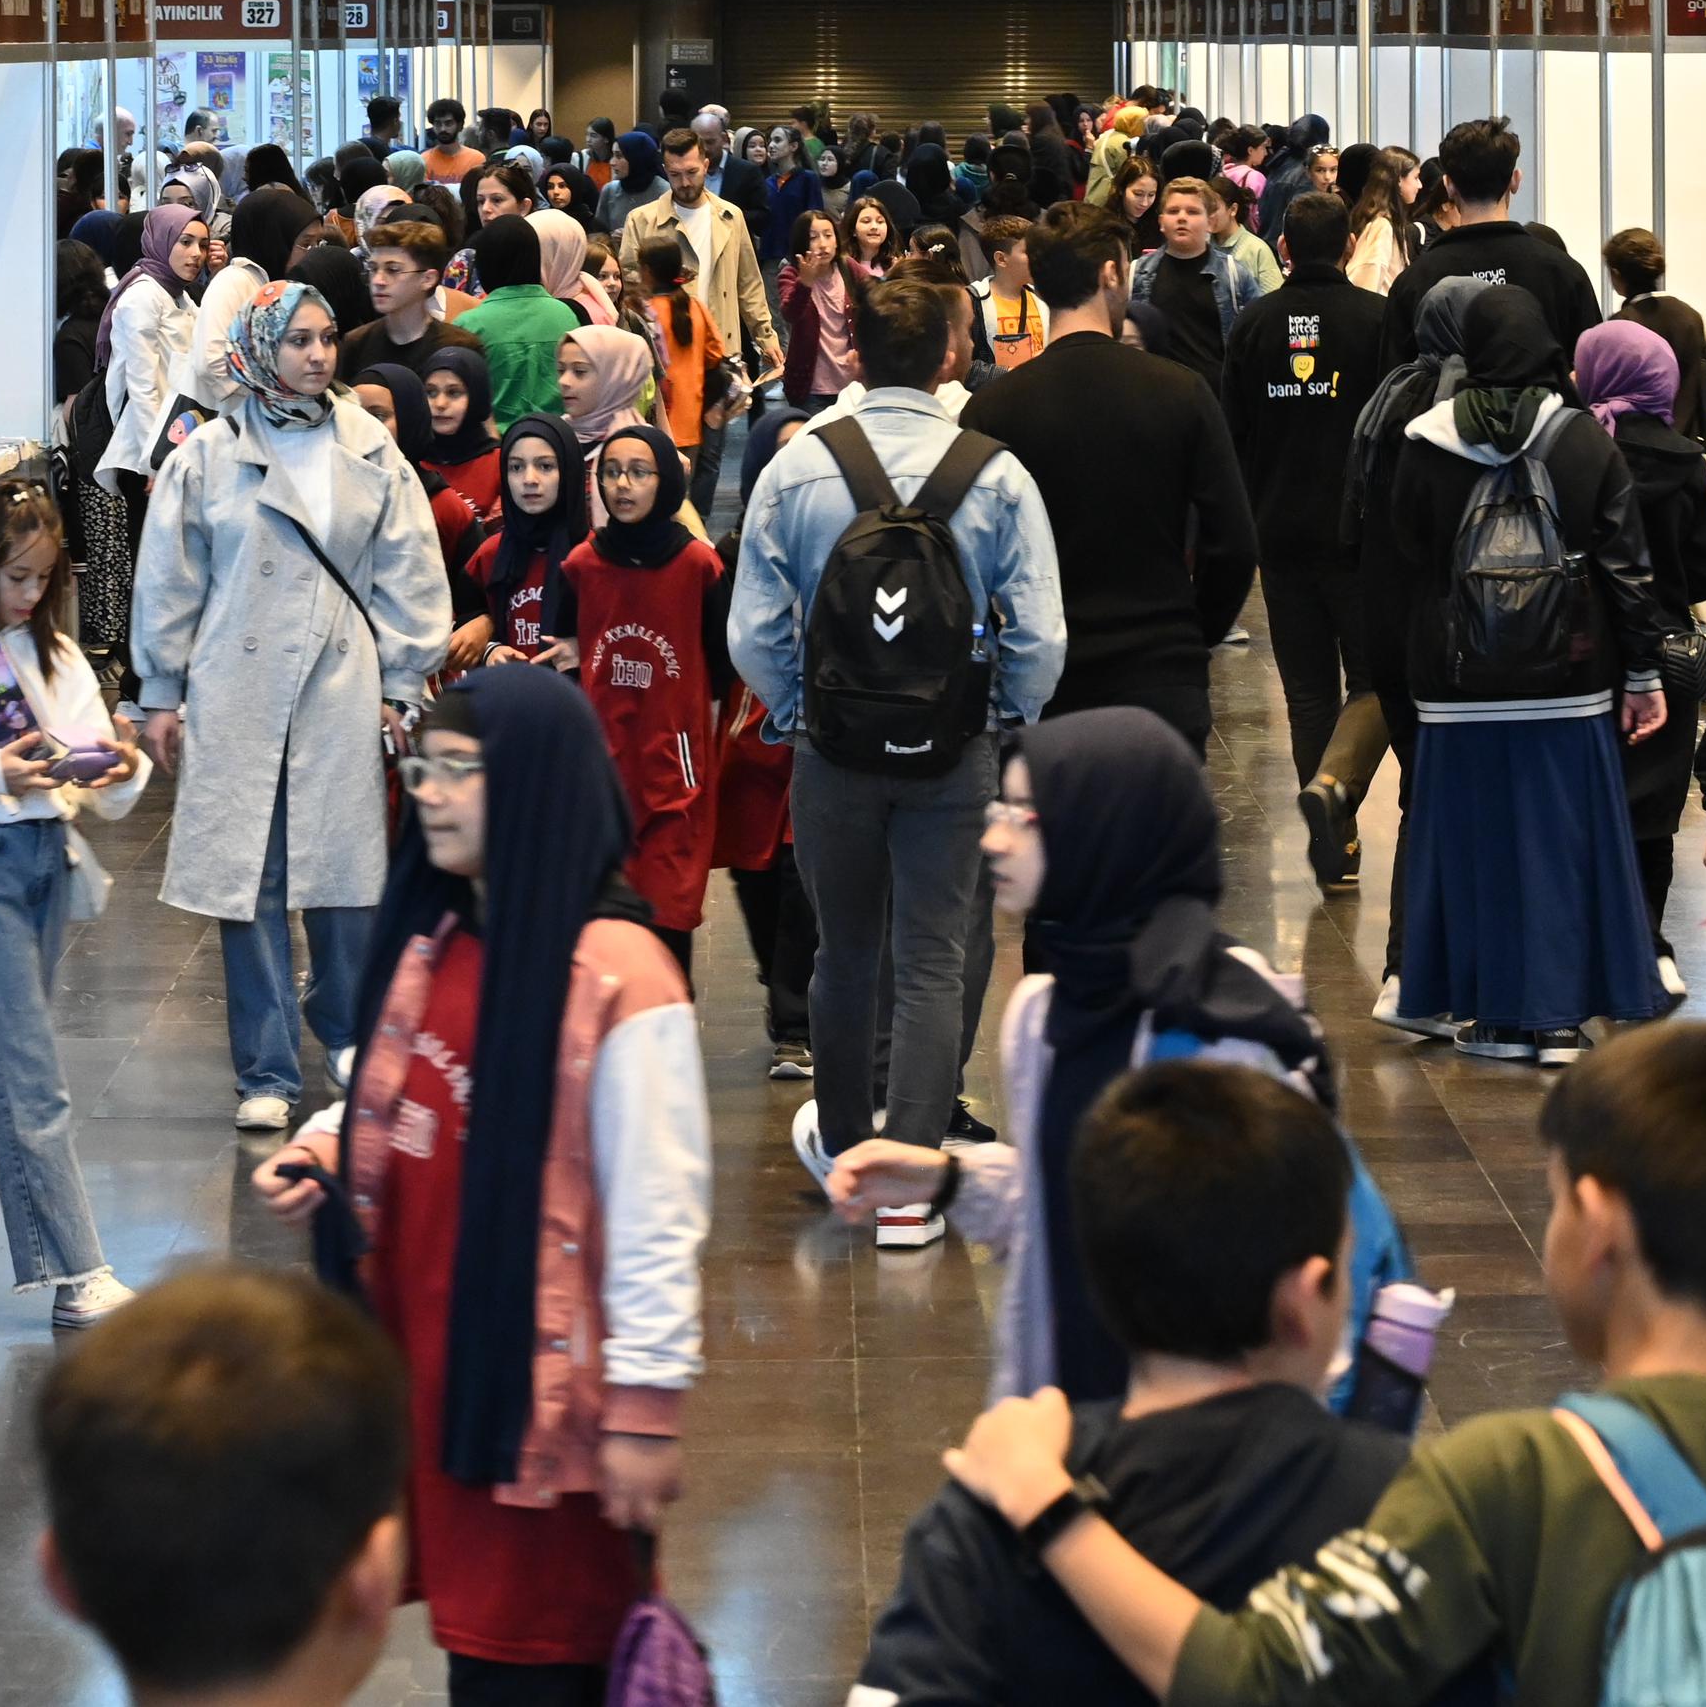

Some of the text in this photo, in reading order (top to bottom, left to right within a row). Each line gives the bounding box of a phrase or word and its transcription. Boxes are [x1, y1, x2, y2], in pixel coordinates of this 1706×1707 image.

[246, 8, 275, 25] 327
[1473, 267, 1506, 282] konya
[1267, 370, 1340, 399] bana sor!
